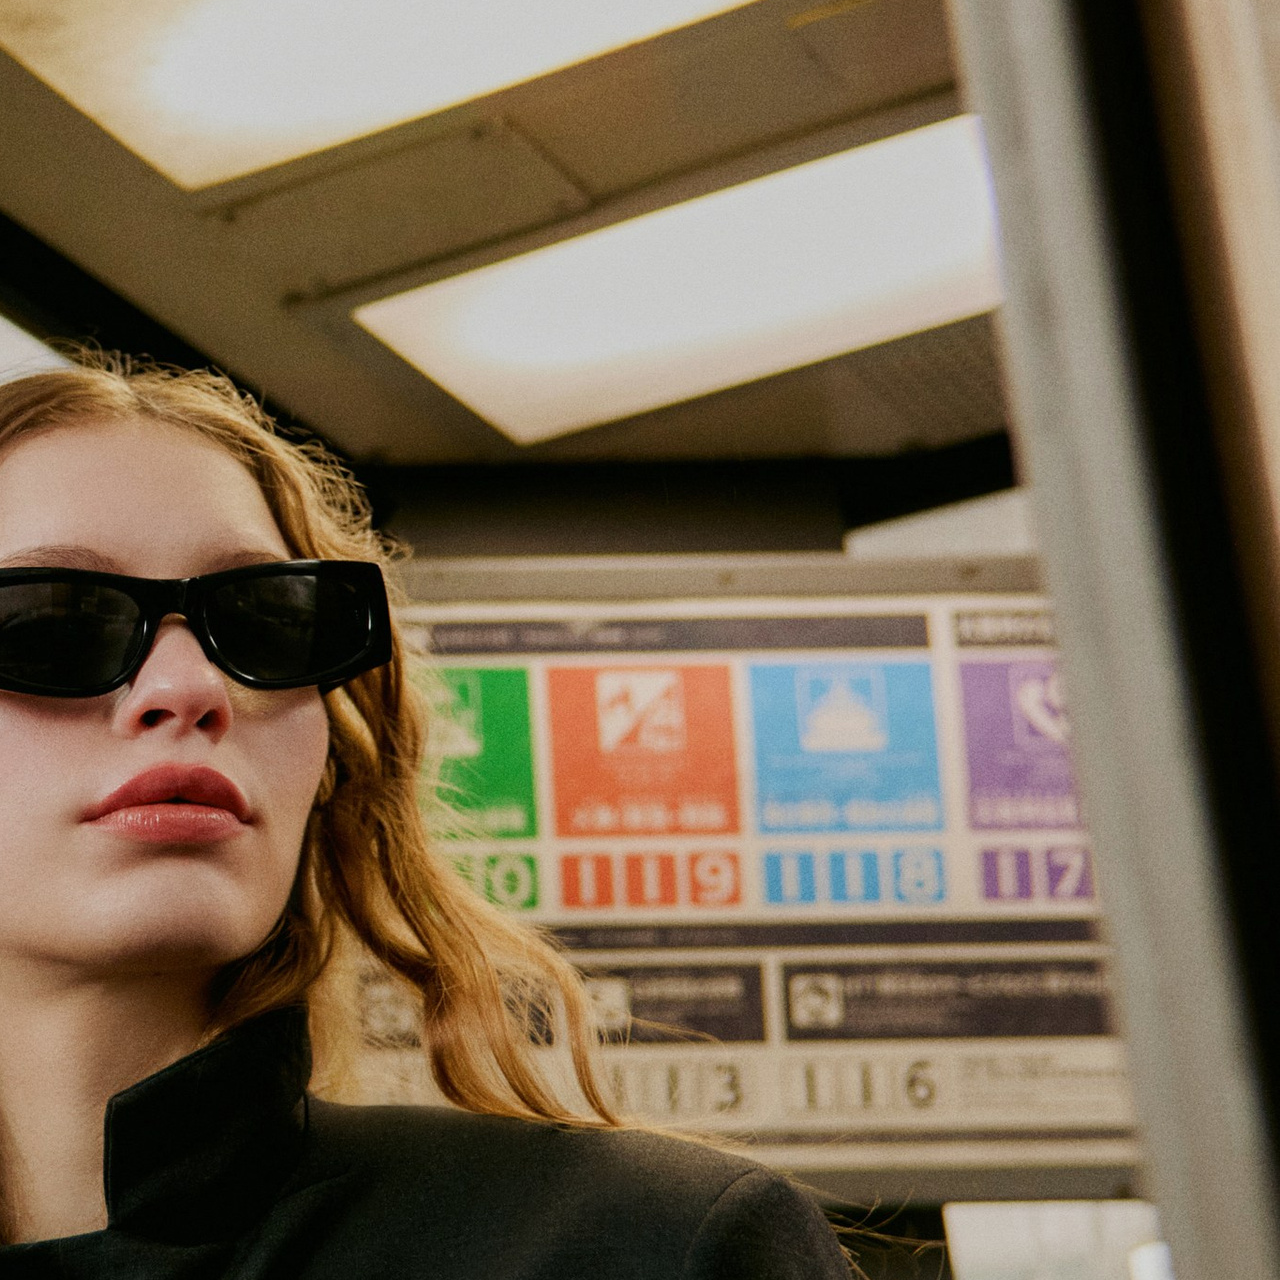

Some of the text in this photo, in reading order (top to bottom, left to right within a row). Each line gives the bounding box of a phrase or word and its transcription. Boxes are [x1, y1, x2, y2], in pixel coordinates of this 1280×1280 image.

[579, 856, 735, 902] 119
[782, 851, 938, 901] 118
[997, 850, 1084, 899] 17
[805, 1059, 936, 1109] 116
